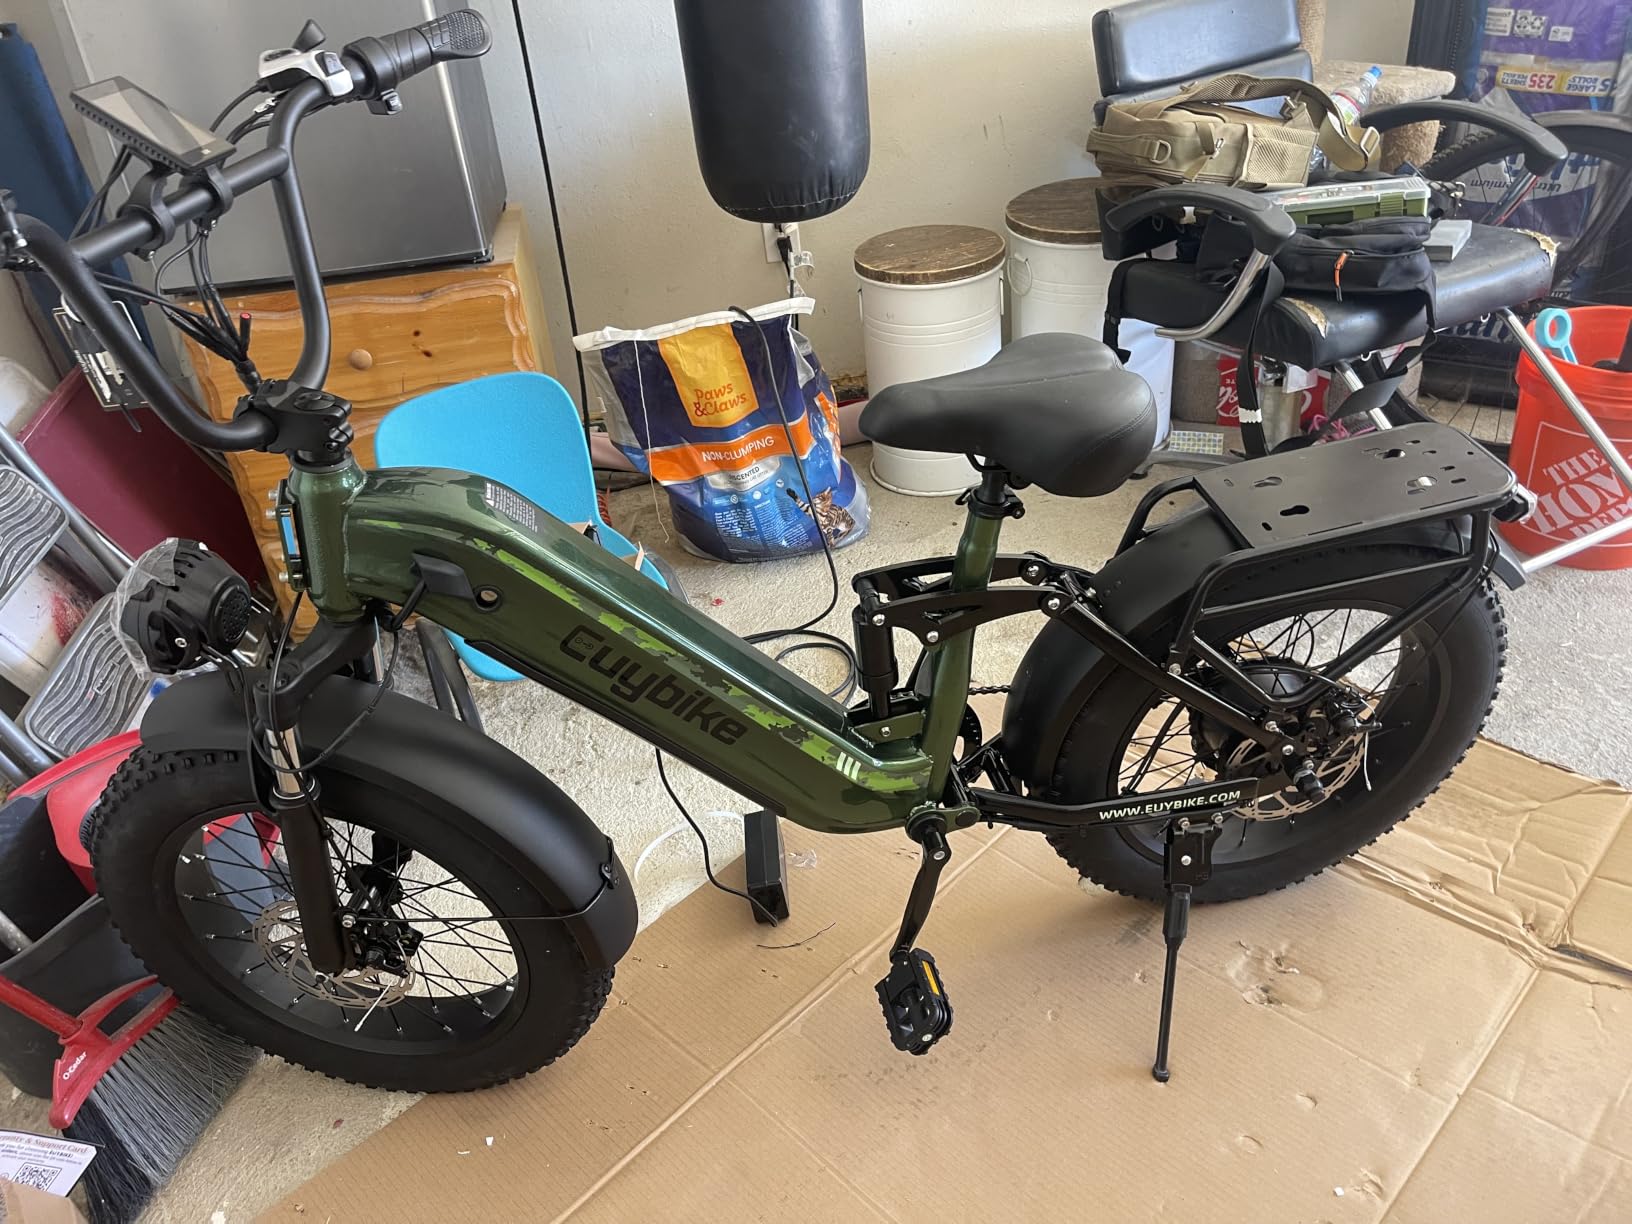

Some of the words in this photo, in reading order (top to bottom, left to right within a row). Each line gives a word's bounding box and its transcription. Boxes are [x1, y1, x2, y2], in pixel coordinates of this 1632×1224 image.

[1501, 77, 1527, 87] SHEETS
[1528, 73, 1556, 89] 235
[1566, 83, 1597, 93] LARGE
[694, 383, 734, 401] Paws
[702, 436, 775, 462] NON-CLUMPING
[1542, 448, 1607, 486] THE
[1530, 466, 1626, 535] HOM
[1099, 790, 1241, 820] WWW.EUYBIKE.COM
[34, 1139, 66, 1151] Support
[67, 1144, 88, 1153] Card
